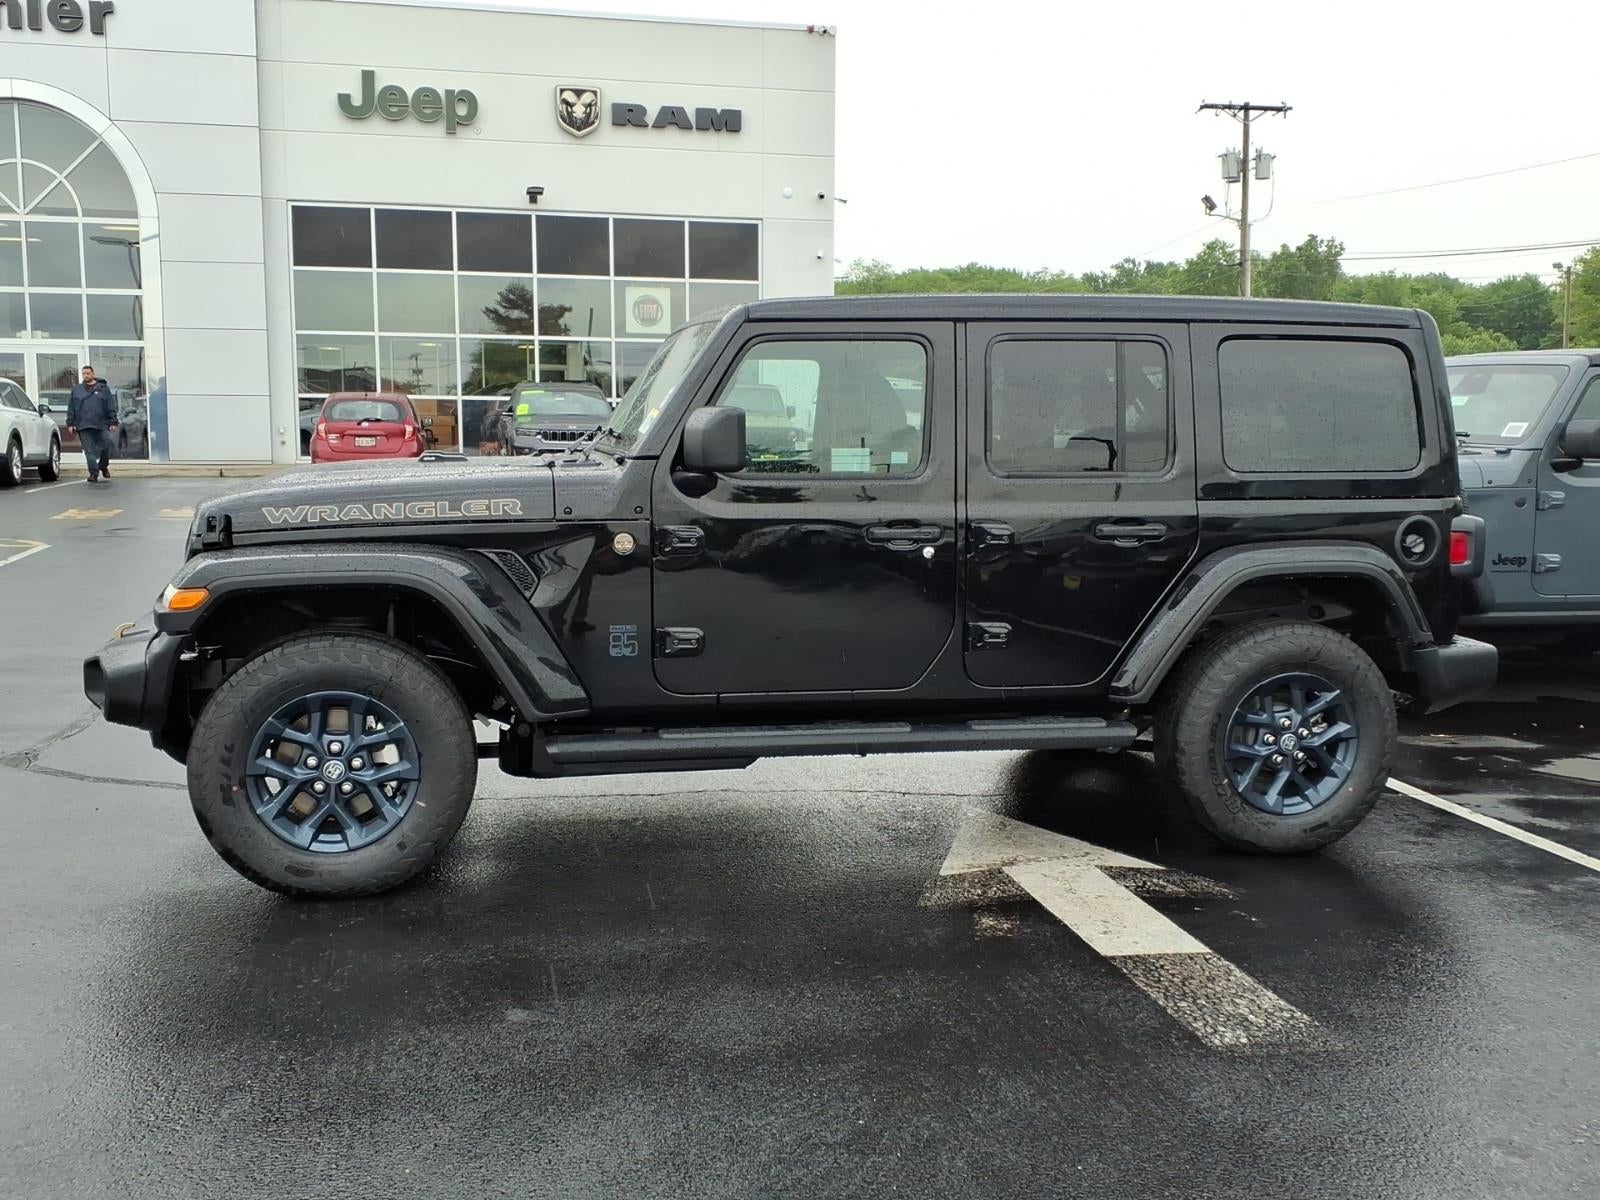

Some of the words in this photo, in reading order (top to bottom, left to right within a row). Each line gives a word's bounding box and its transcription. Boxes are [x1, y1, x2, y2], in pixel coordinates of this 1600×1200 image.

[337, 69, 479, 135] Jeep
[611, 102, 742, 132] RAM
[639, 303, 658, 320] FIAT
[261, 498, 523, 524] WRANGLER
[1491, 553, 1527, 567] Jeep
